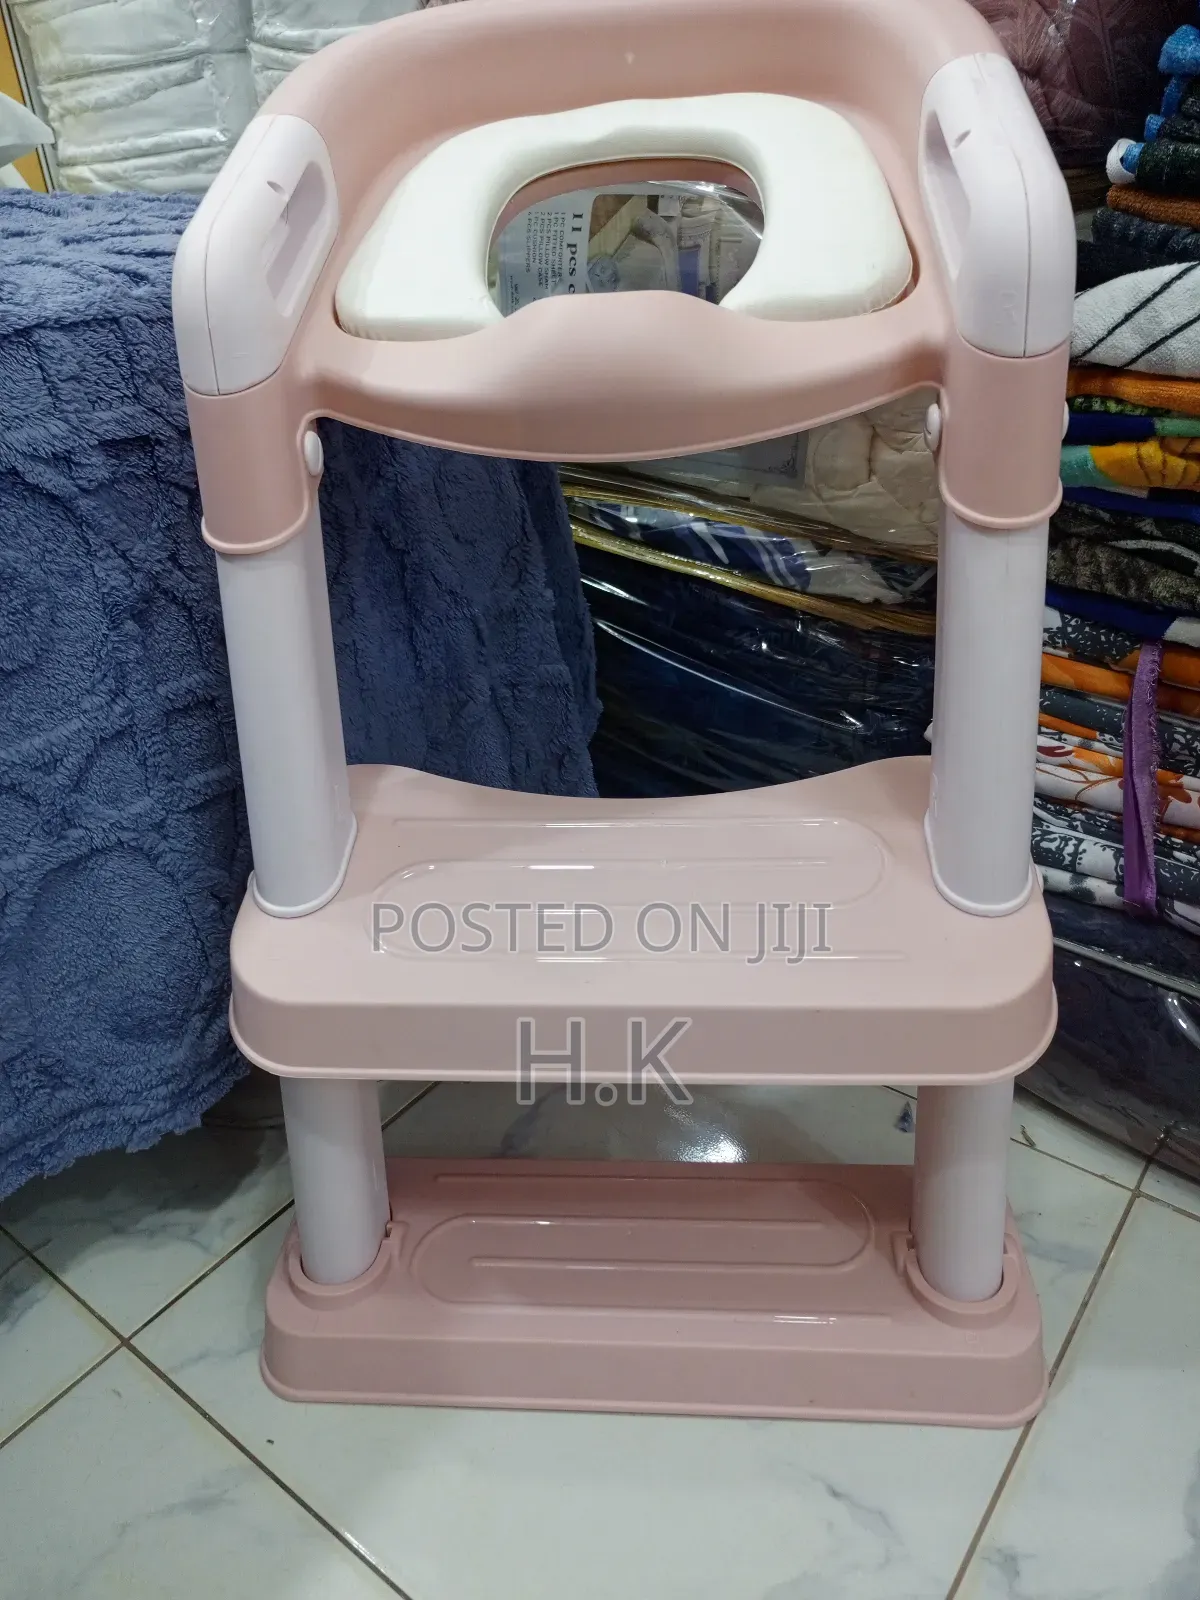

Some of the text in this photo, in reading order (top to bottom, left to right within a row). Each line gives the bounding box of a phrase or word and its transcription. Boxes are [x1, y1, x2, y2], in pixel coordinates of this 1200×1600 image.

[553, 216, 558, 227] PC
[560, 217, 566, 228] PC
[572, 213, 583, 232] 11
[567, 243, 577, 276] pcs
